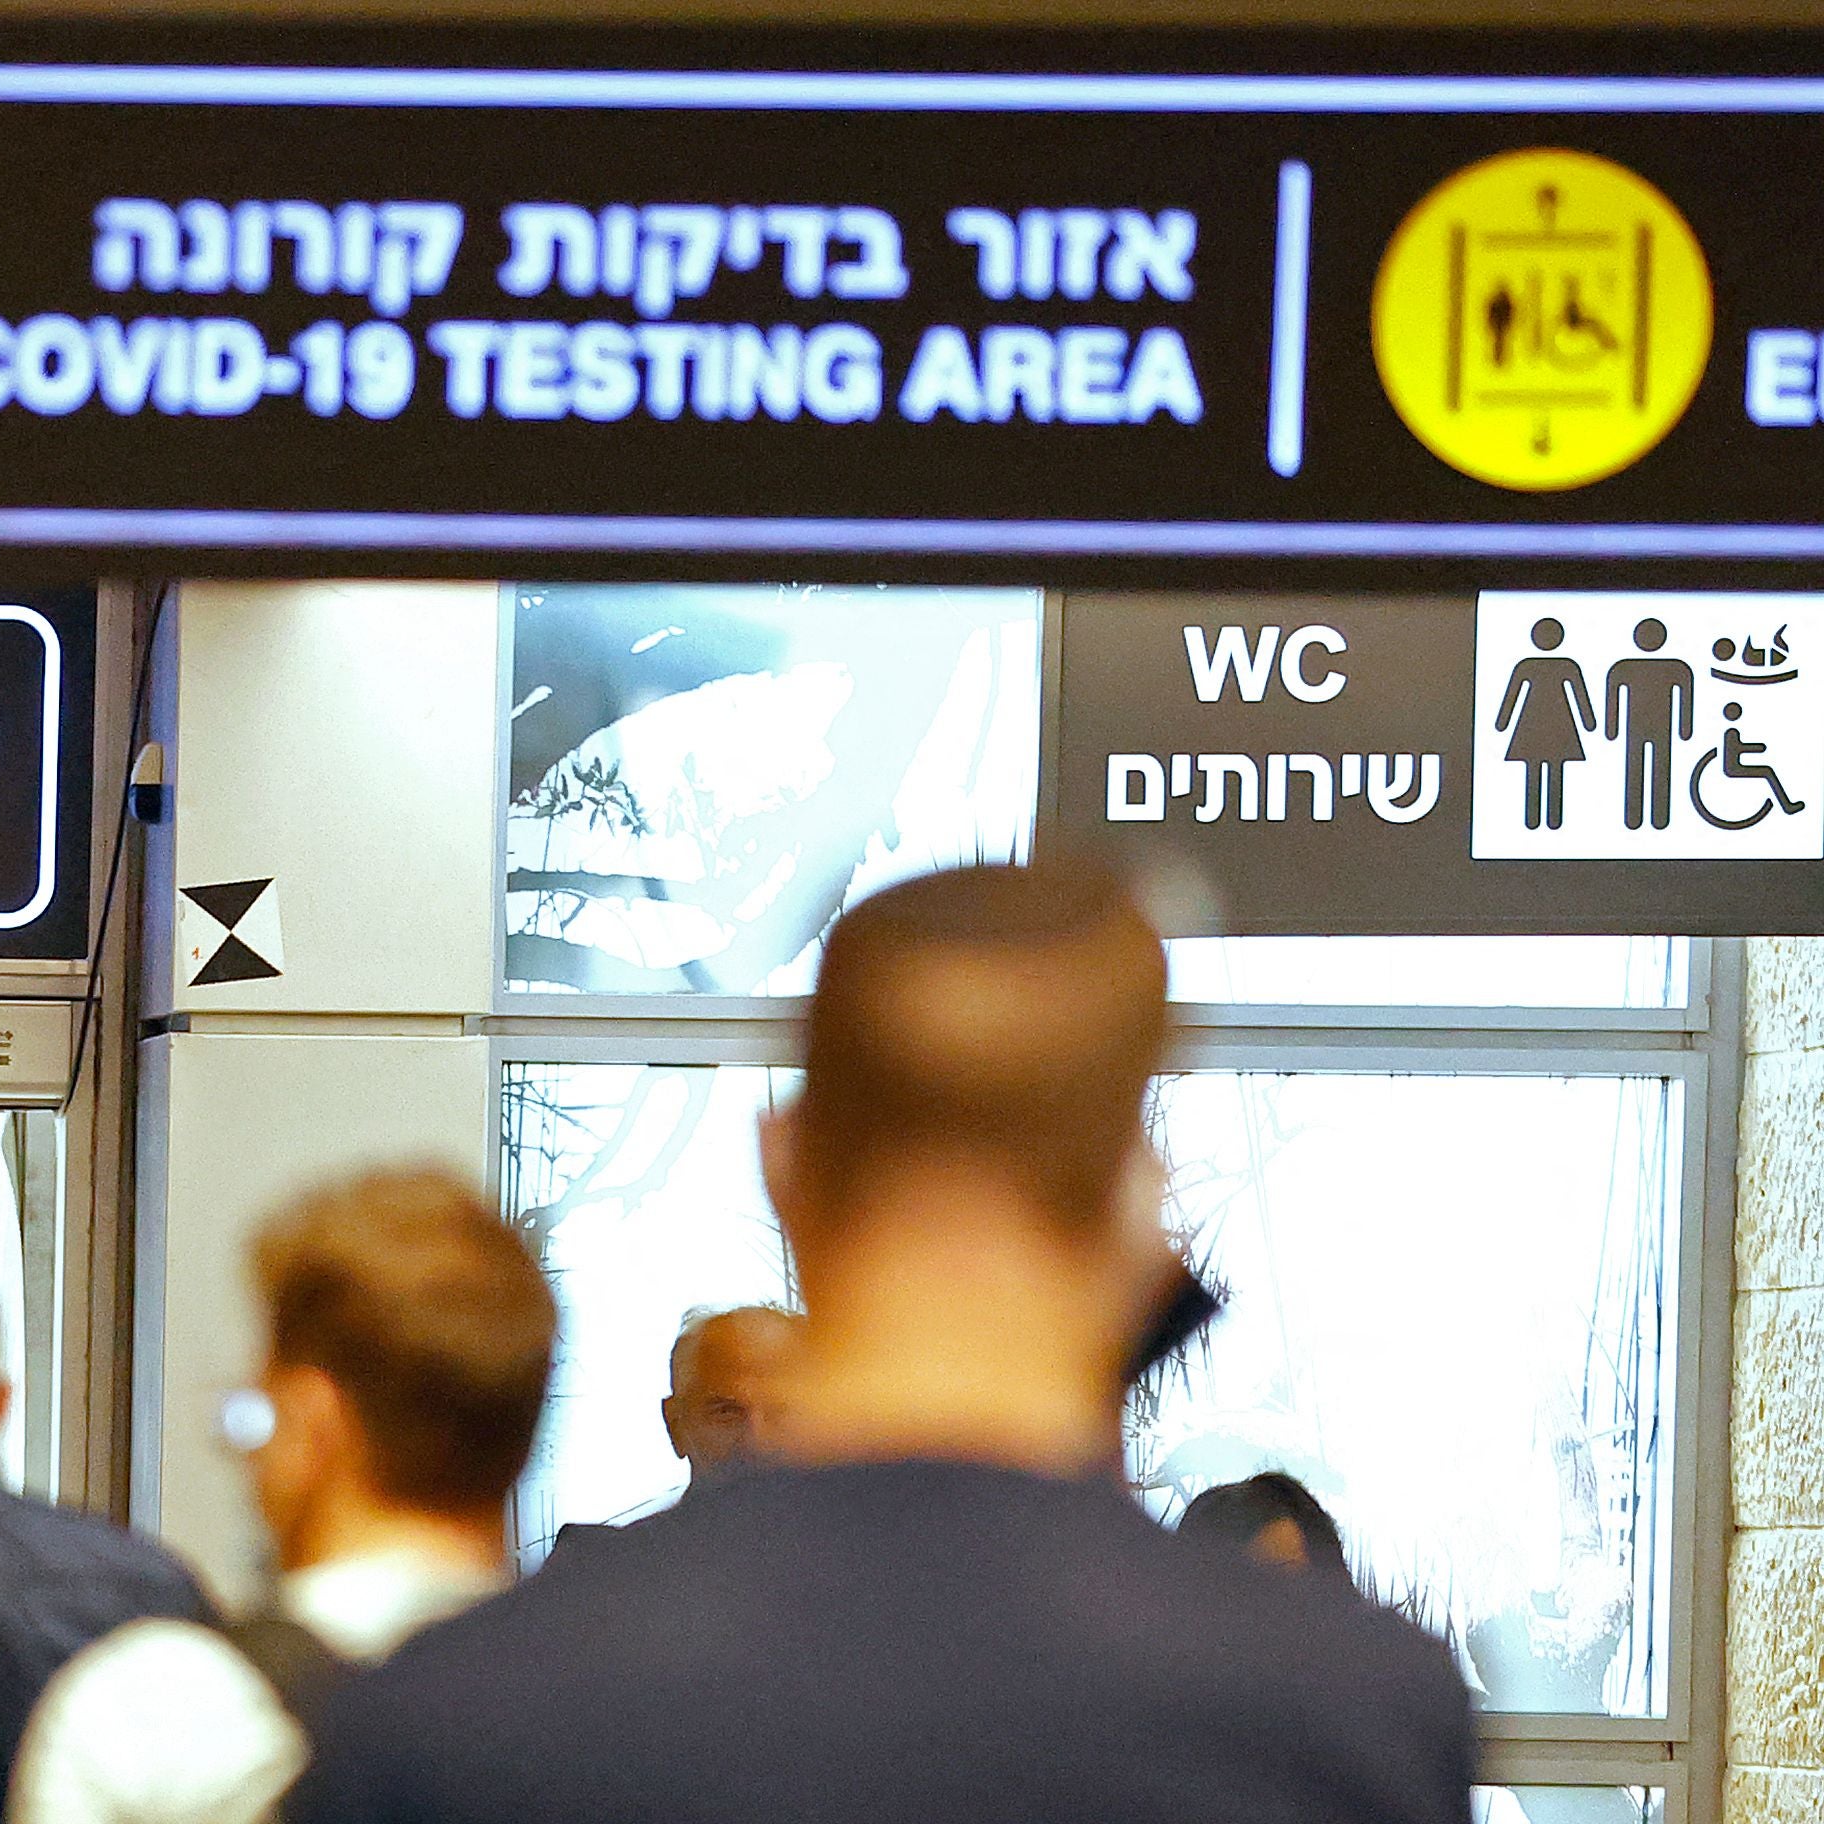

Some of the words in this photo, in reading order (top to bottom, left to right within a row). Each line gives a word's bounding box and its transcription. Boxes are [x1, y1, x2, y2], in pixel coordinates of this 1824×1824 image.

[95, 199, 462, 312] קורונה
[502, 204, 907, 315] בדיקות
[951, 208, 1196, 298] אזור
[429, 321, 882, 421] TESTING
[903, 327, 1201, 423] AREA
[1745, 327, 1824, 428] E
[1184, 625, 1347, 703] WC
[1106, 753, 1440, 823] שירותים
